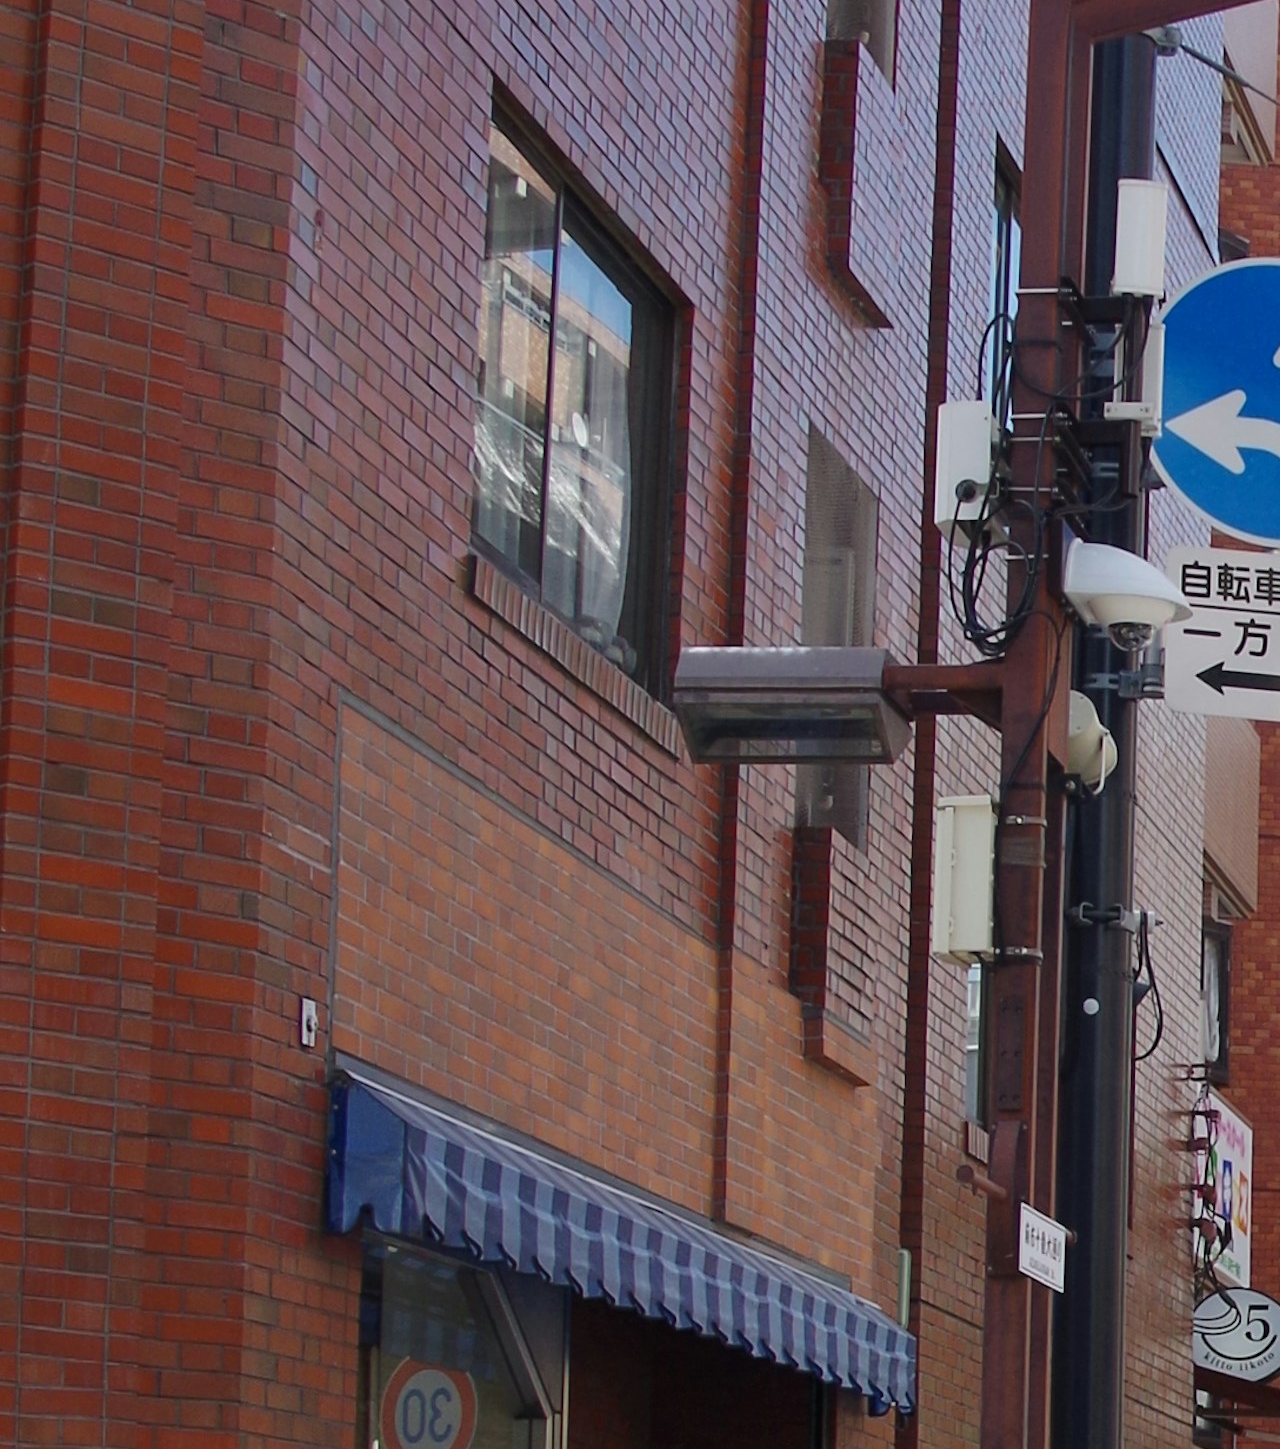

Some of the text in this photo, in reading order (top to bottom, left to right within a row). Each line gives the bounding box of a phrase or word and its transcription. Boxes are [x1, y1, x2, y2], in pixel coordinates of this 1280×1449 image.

[1245, 1304, 1270, 1342] 5
[1203, 1351, 1275, 1371] kitto iikoto
